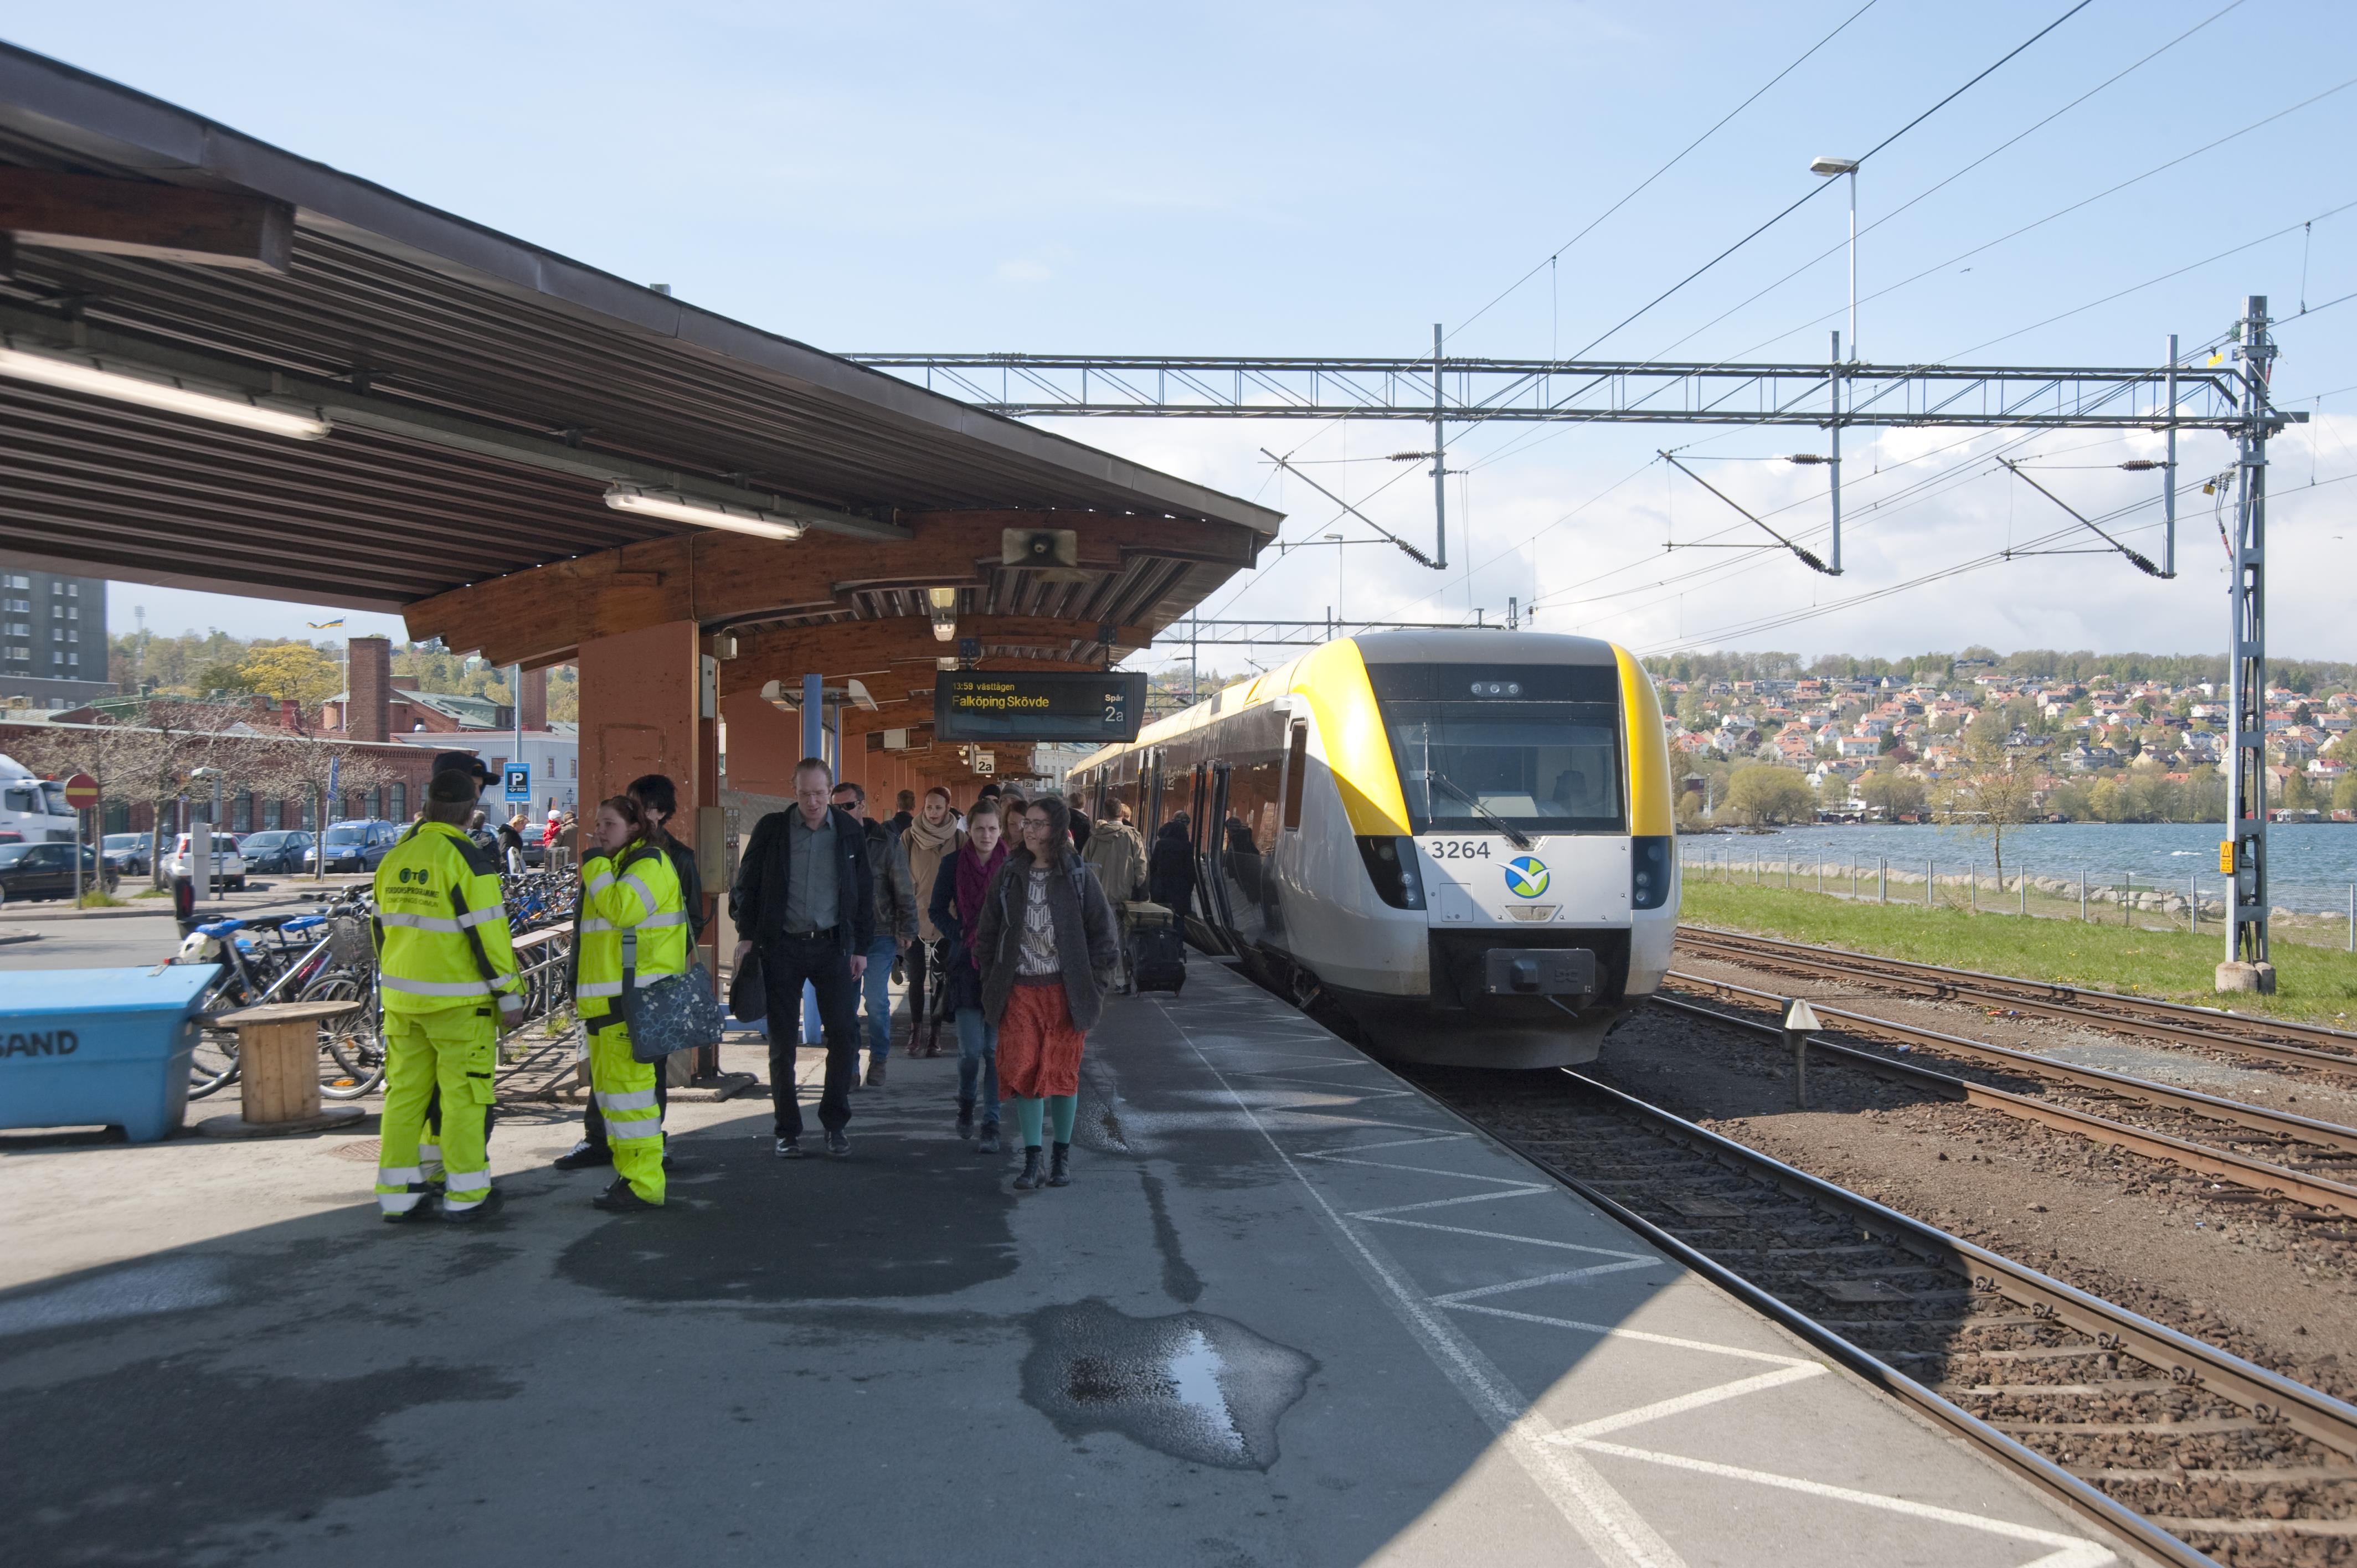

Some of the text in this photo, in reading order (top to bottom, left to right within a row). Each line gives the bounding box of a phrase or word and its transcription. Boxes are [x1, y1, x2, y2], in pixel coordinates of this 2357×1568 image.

[976, 682, 1015, 692] västtågen
[952, 695, 1049, 709] Falköping Skövde
[1105, 694, 1124, 703] Spår
[1105, 706, 1124, 721] 2a
[978, 761, 992, 771] 2a
[512, 772, 523, 785] P
[1432, 841, 1491, 859] 3264
[0, 1030, 79, 1058] AND
